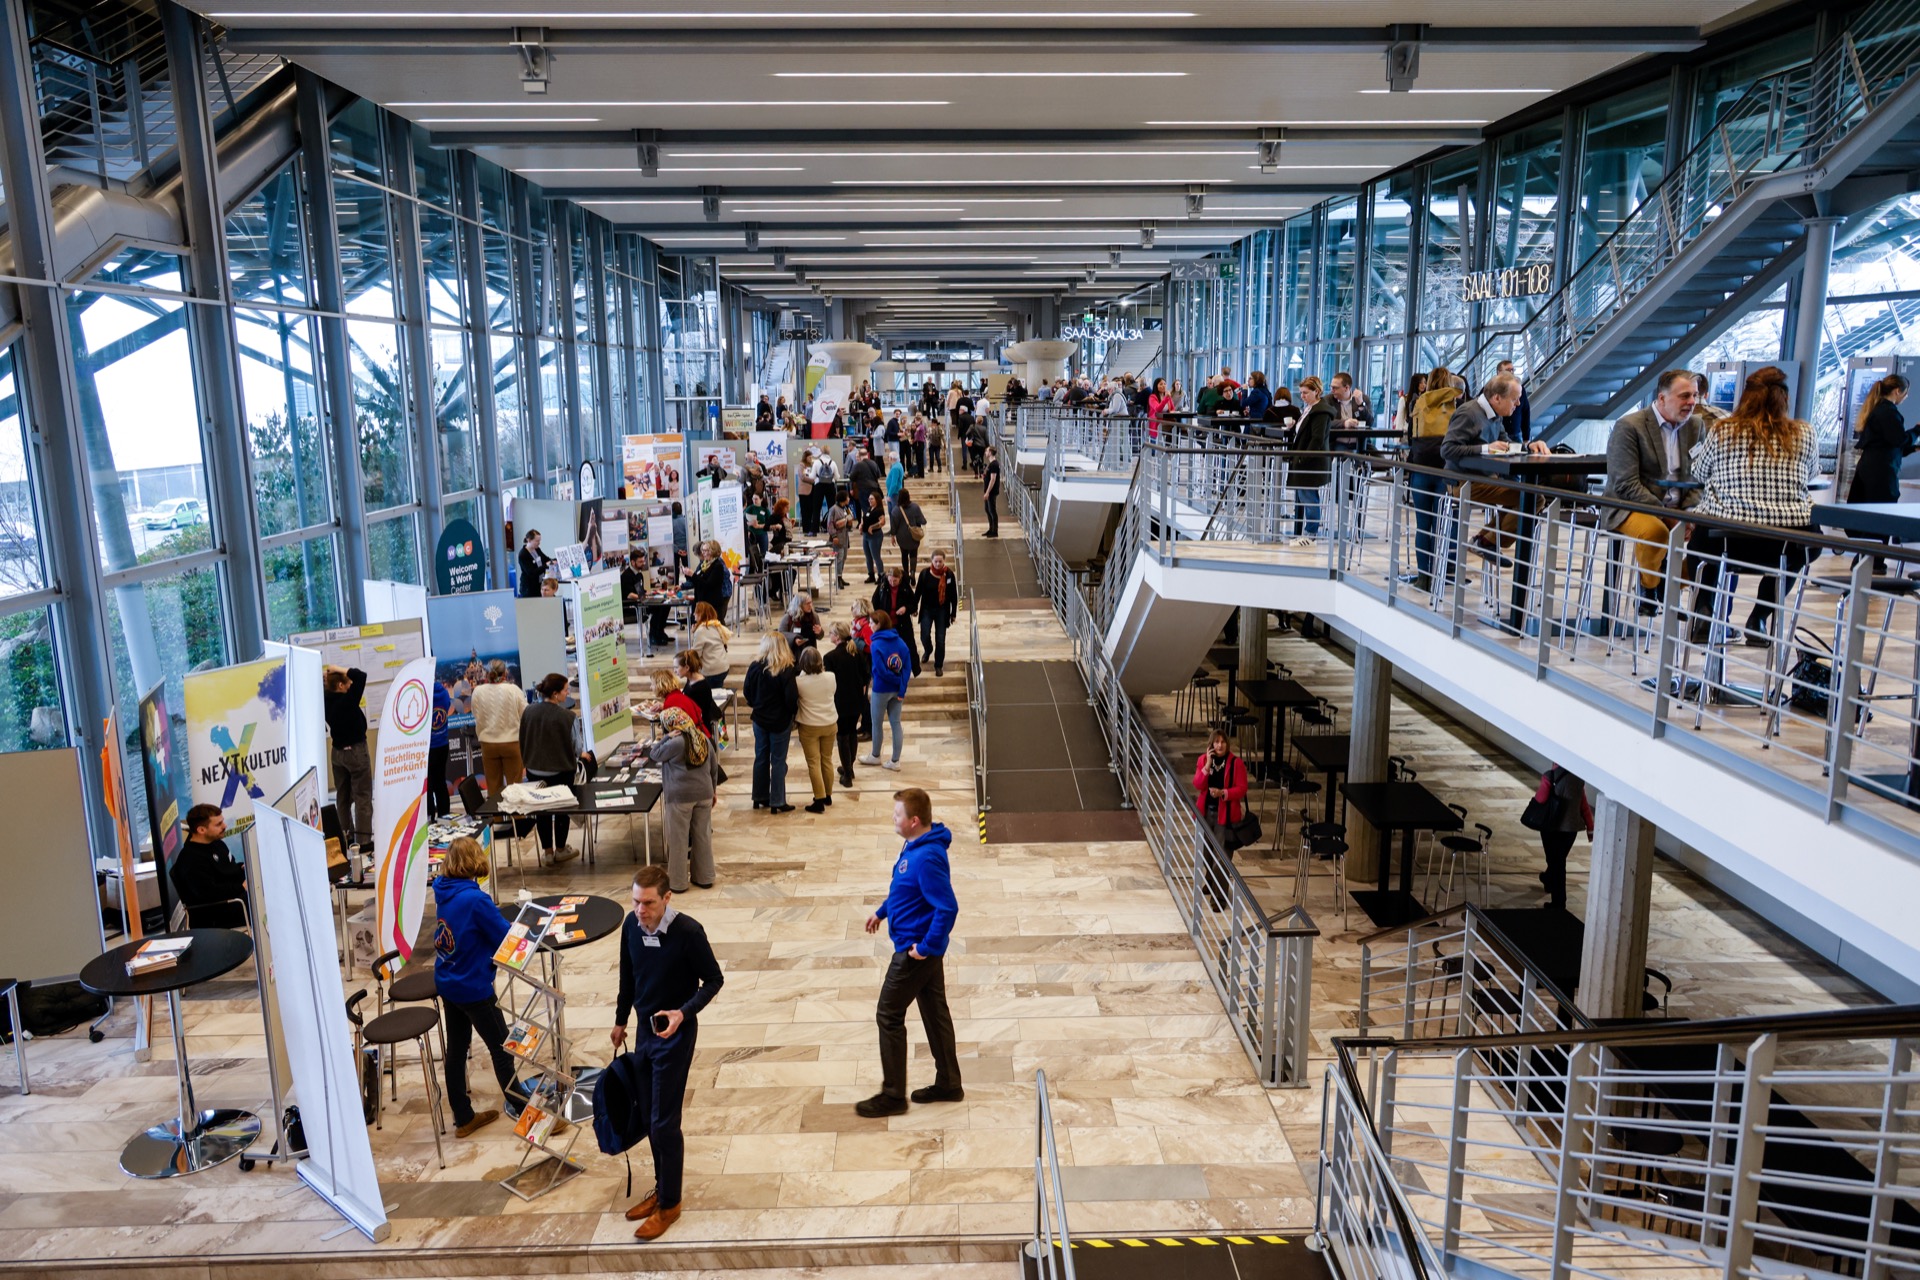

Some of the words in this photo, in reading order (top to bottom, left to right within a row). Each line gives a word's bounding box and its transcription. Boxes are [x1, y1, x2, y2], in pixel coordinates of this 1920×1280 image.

[1462, 271, 1496, 302] SAAL
[1498, 263, 1550, 298] 101-108
[780, 329, 793, 341] 15
[804, 328, 818, 341] 18
[1063, 327, 1094, 340] SAAL
[1101, 329, 1128, 341] SAAL
[449, 562, 478, 577] Welcome
[450, 576, 456, 586] &
[455, 572, 473, 585] Work
[450, 583, 472, 595] Center
[384, 740, 428, 754] Unterstützerkreis
[384, 750, 428, 767] Flüchtlings-
[383, 775, 407, 787] Hannover
